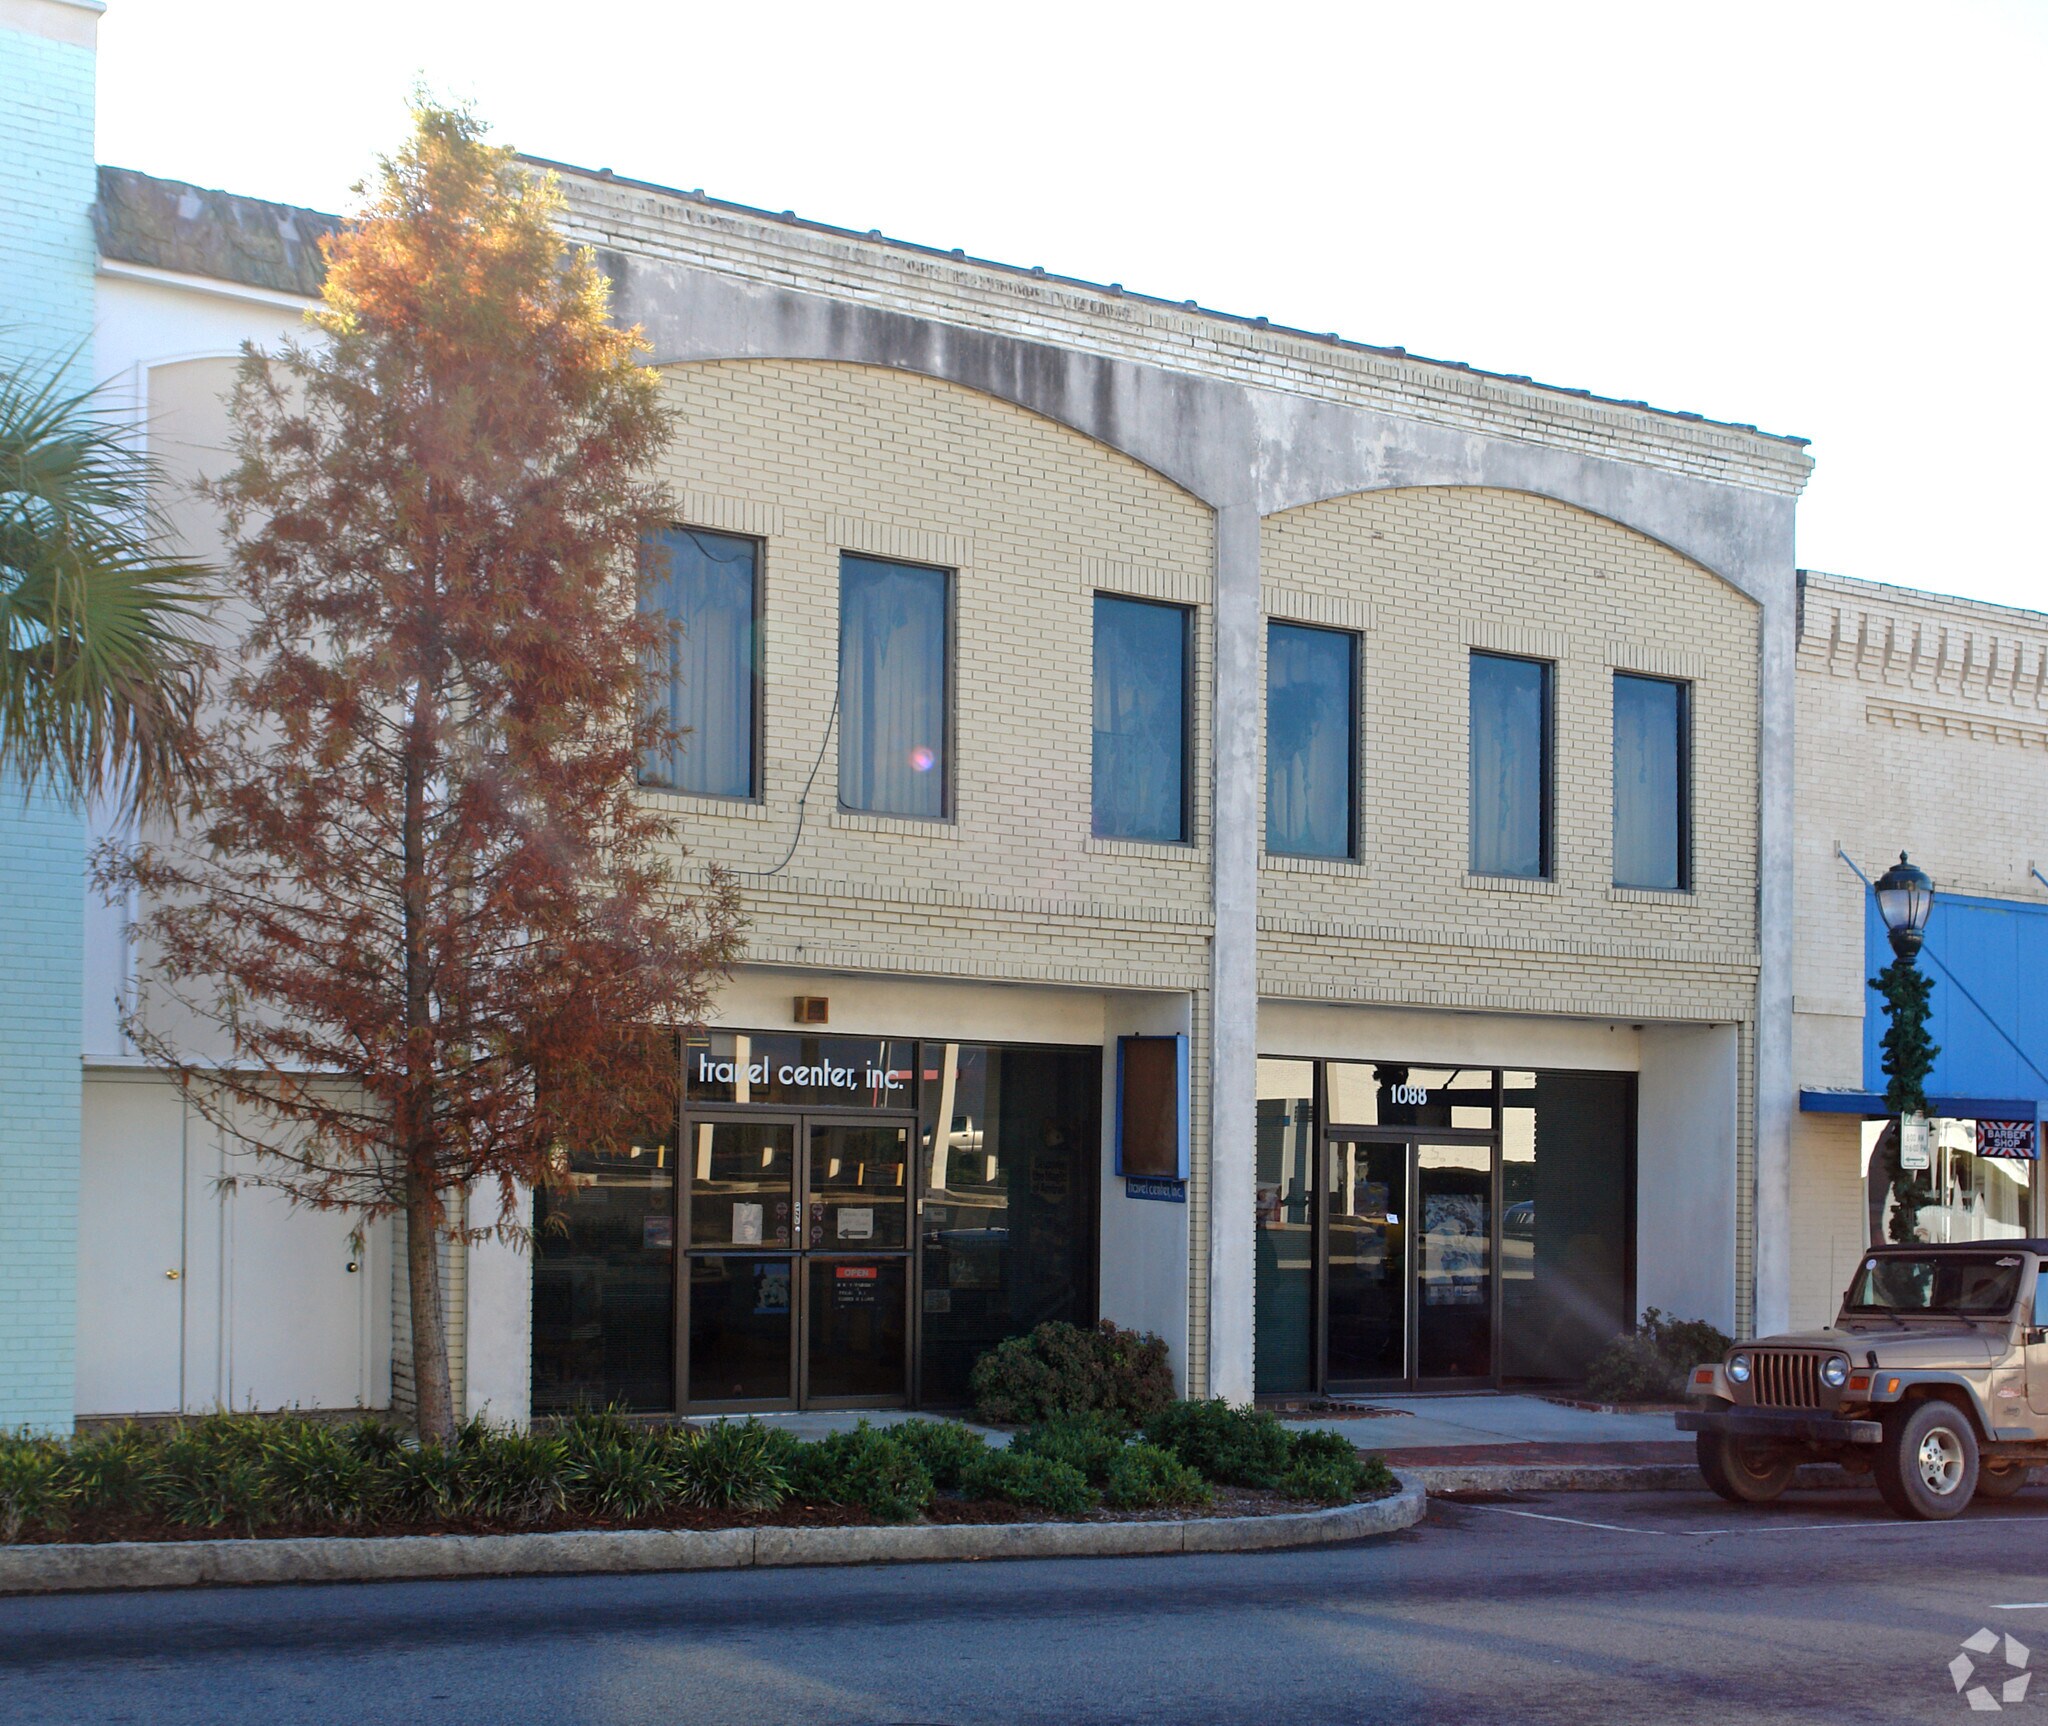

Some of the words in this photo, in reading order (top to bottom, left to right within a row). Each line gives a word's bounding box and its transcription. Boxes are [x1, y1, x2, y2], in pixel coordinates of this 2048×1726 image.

[700, 1053, 769, 1084] travel
[778, 1058, 857, 1090] center,
[866, 1060, 904, 1089] inc.
[1391, 1084, 1427, 1105] 1088
[1987, 1130, 2026, 1140] BARBER
[1994, 1138, 2020, 1148] SHOP
[1127, 1180, 1149, 1195] travel
[844, 1268, 869, 1278] OPEN
